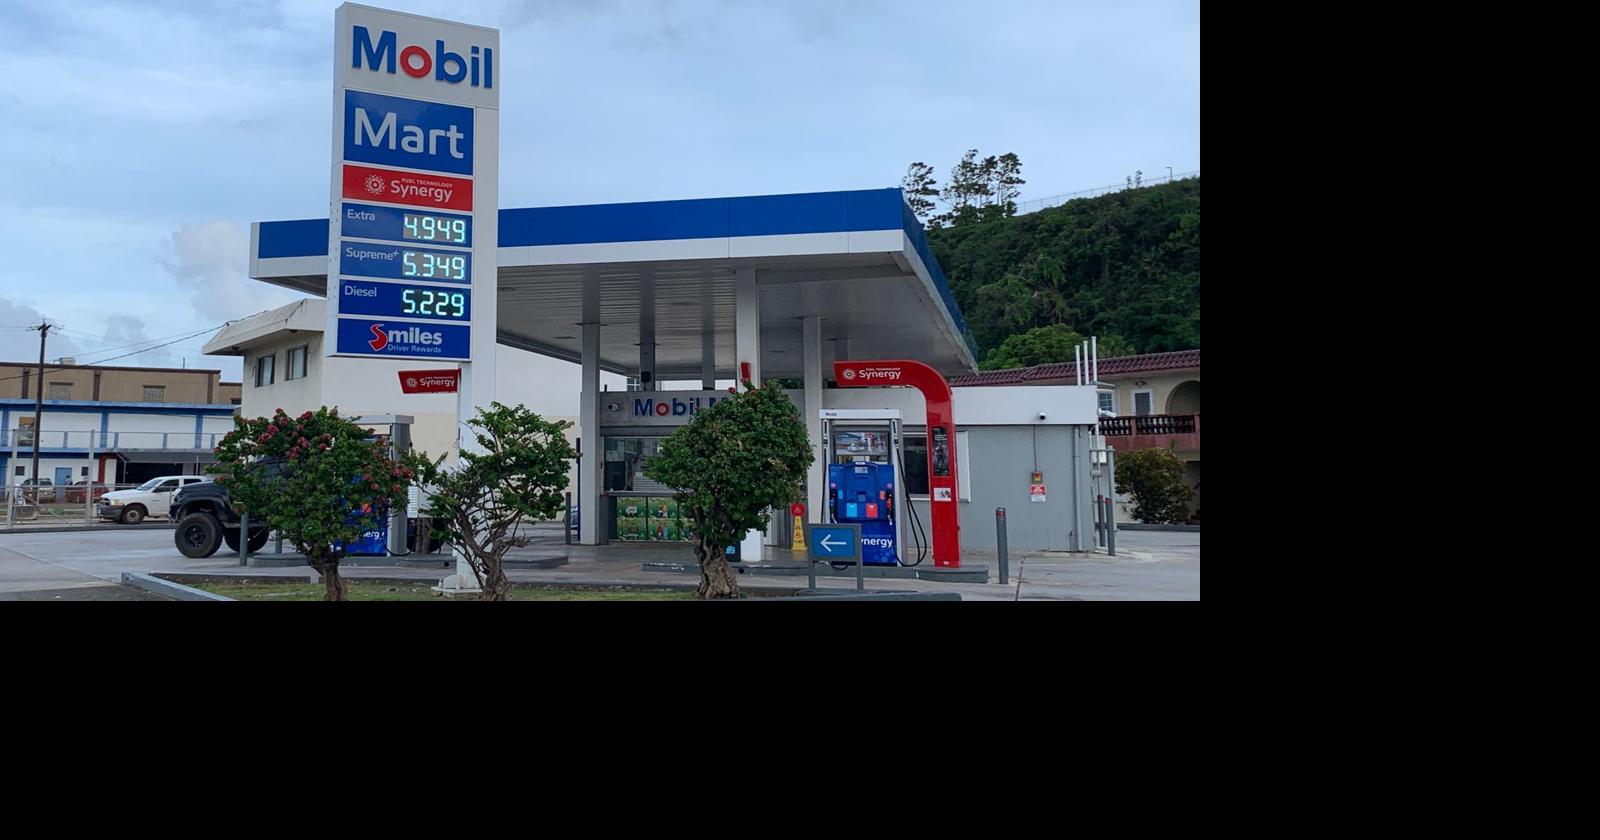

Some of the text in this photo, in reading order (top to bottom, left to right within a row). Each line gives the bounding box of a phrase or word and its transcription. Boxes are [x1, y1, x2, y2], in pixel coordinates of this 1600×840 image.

[352, 25, 493, 88] Mobil
[354, 107, 464, 159] Mart
[390, 179, 453, 202] Synergy
[347, 209, 376, 221] Extra
[404, 216, 466, 243] 4.949
[403, 252, 465, 280] 5.349
[344, 285, 377, 297] Diesel
[402, 289, 465, 317] 5.229
[368, 323, 443, 351] Smiles
[387, 344, 442, 353] Driver Rewards
[419, 378, 455, 388] Synergy
[858, 369, 901, 380] Synergy
